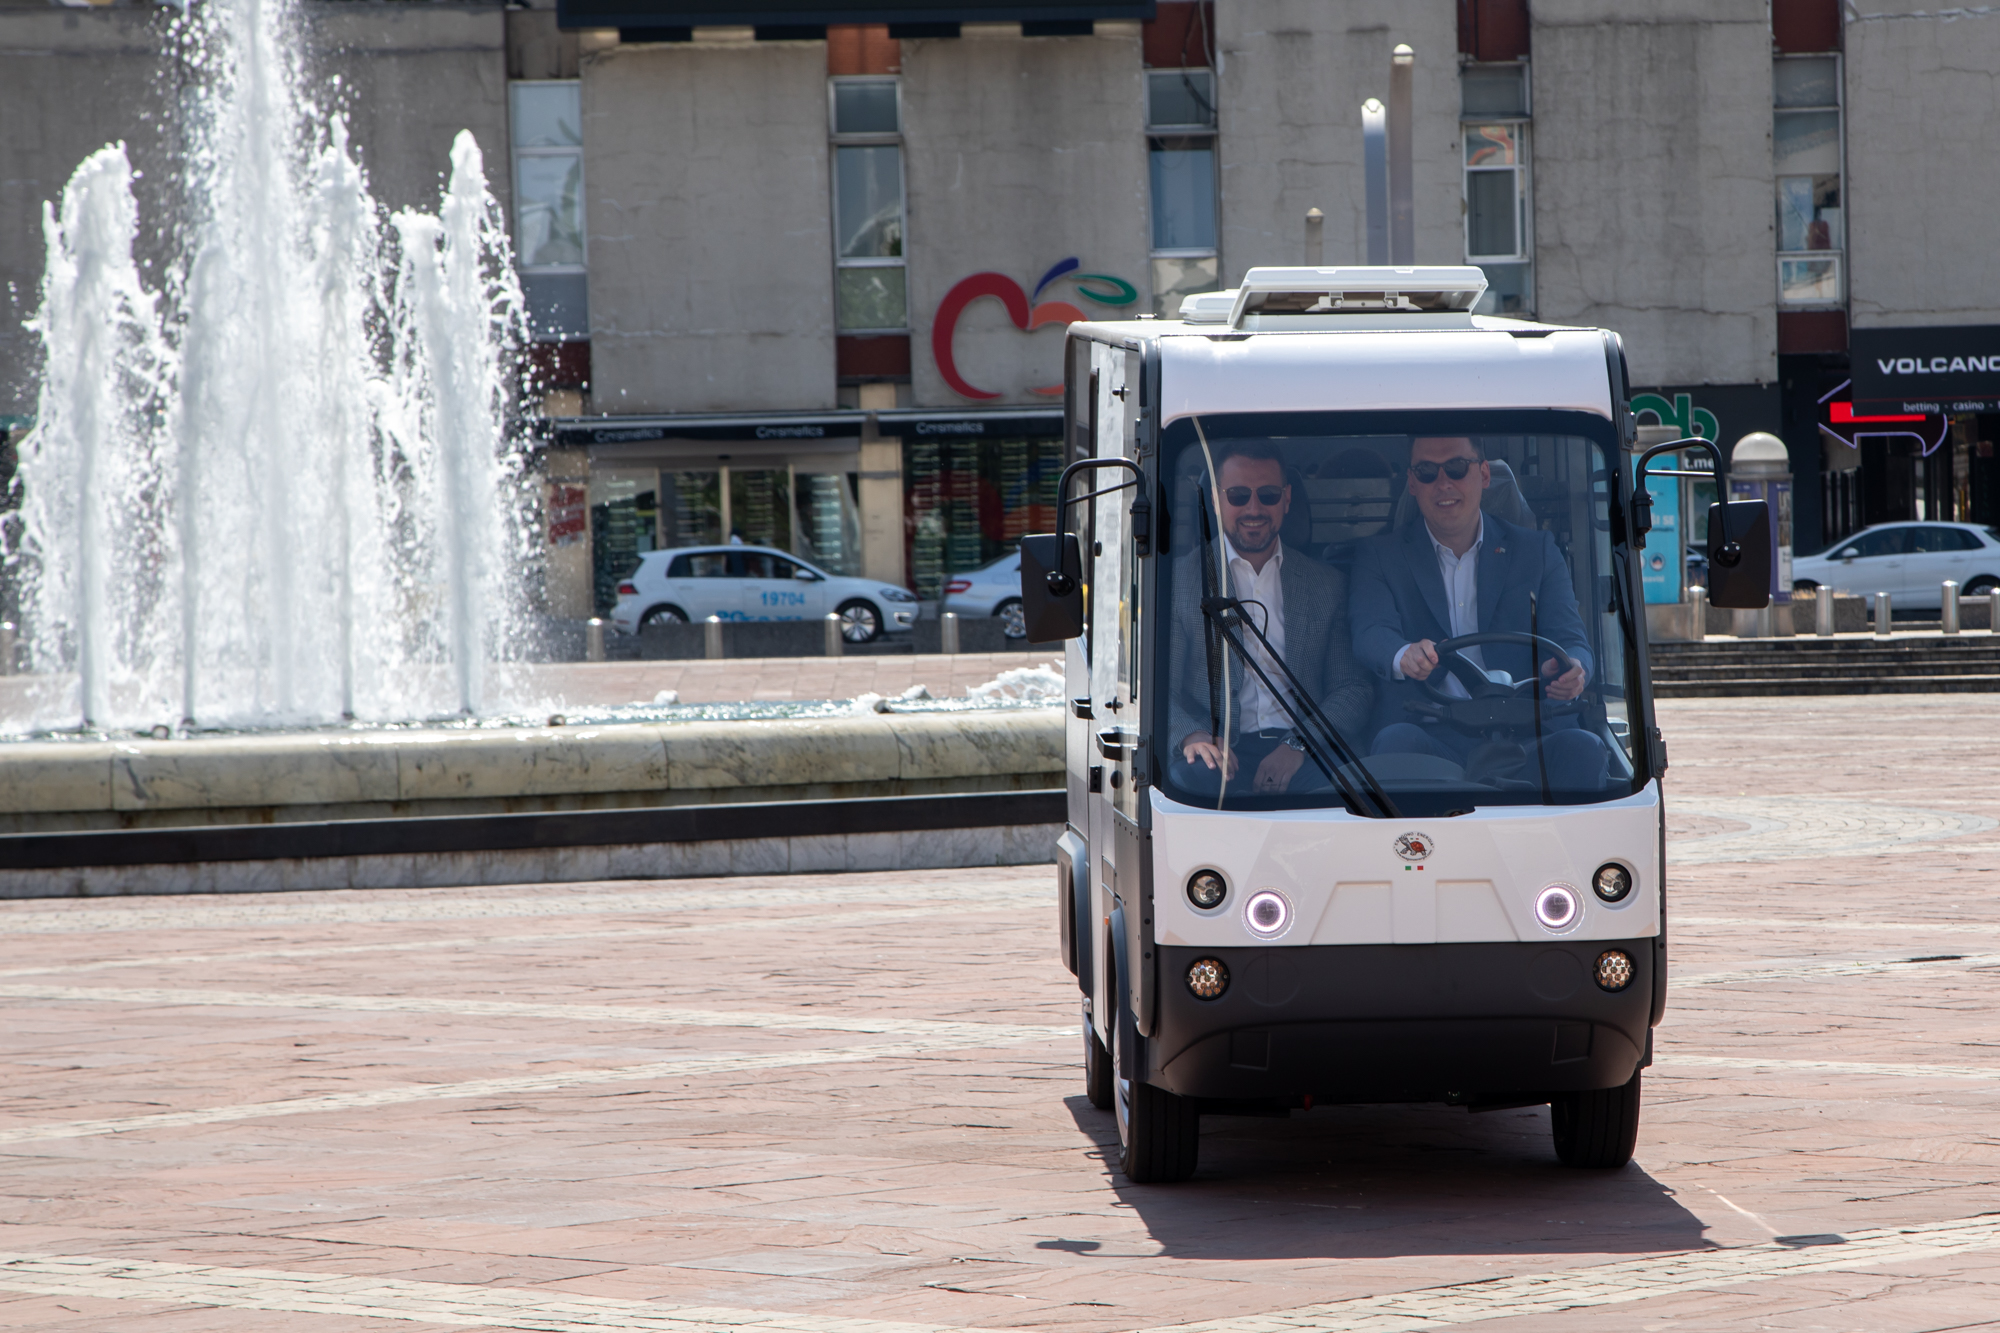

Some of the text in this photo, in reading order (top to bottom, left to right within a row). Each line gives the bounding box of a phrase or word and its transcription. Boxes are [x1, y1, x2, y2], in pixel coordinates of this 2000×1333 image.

[1903, 401, 1985, 413] betting casino
[916, 421, 984, 435] Cosmetics
[761, 591, 805, 606] 19704
